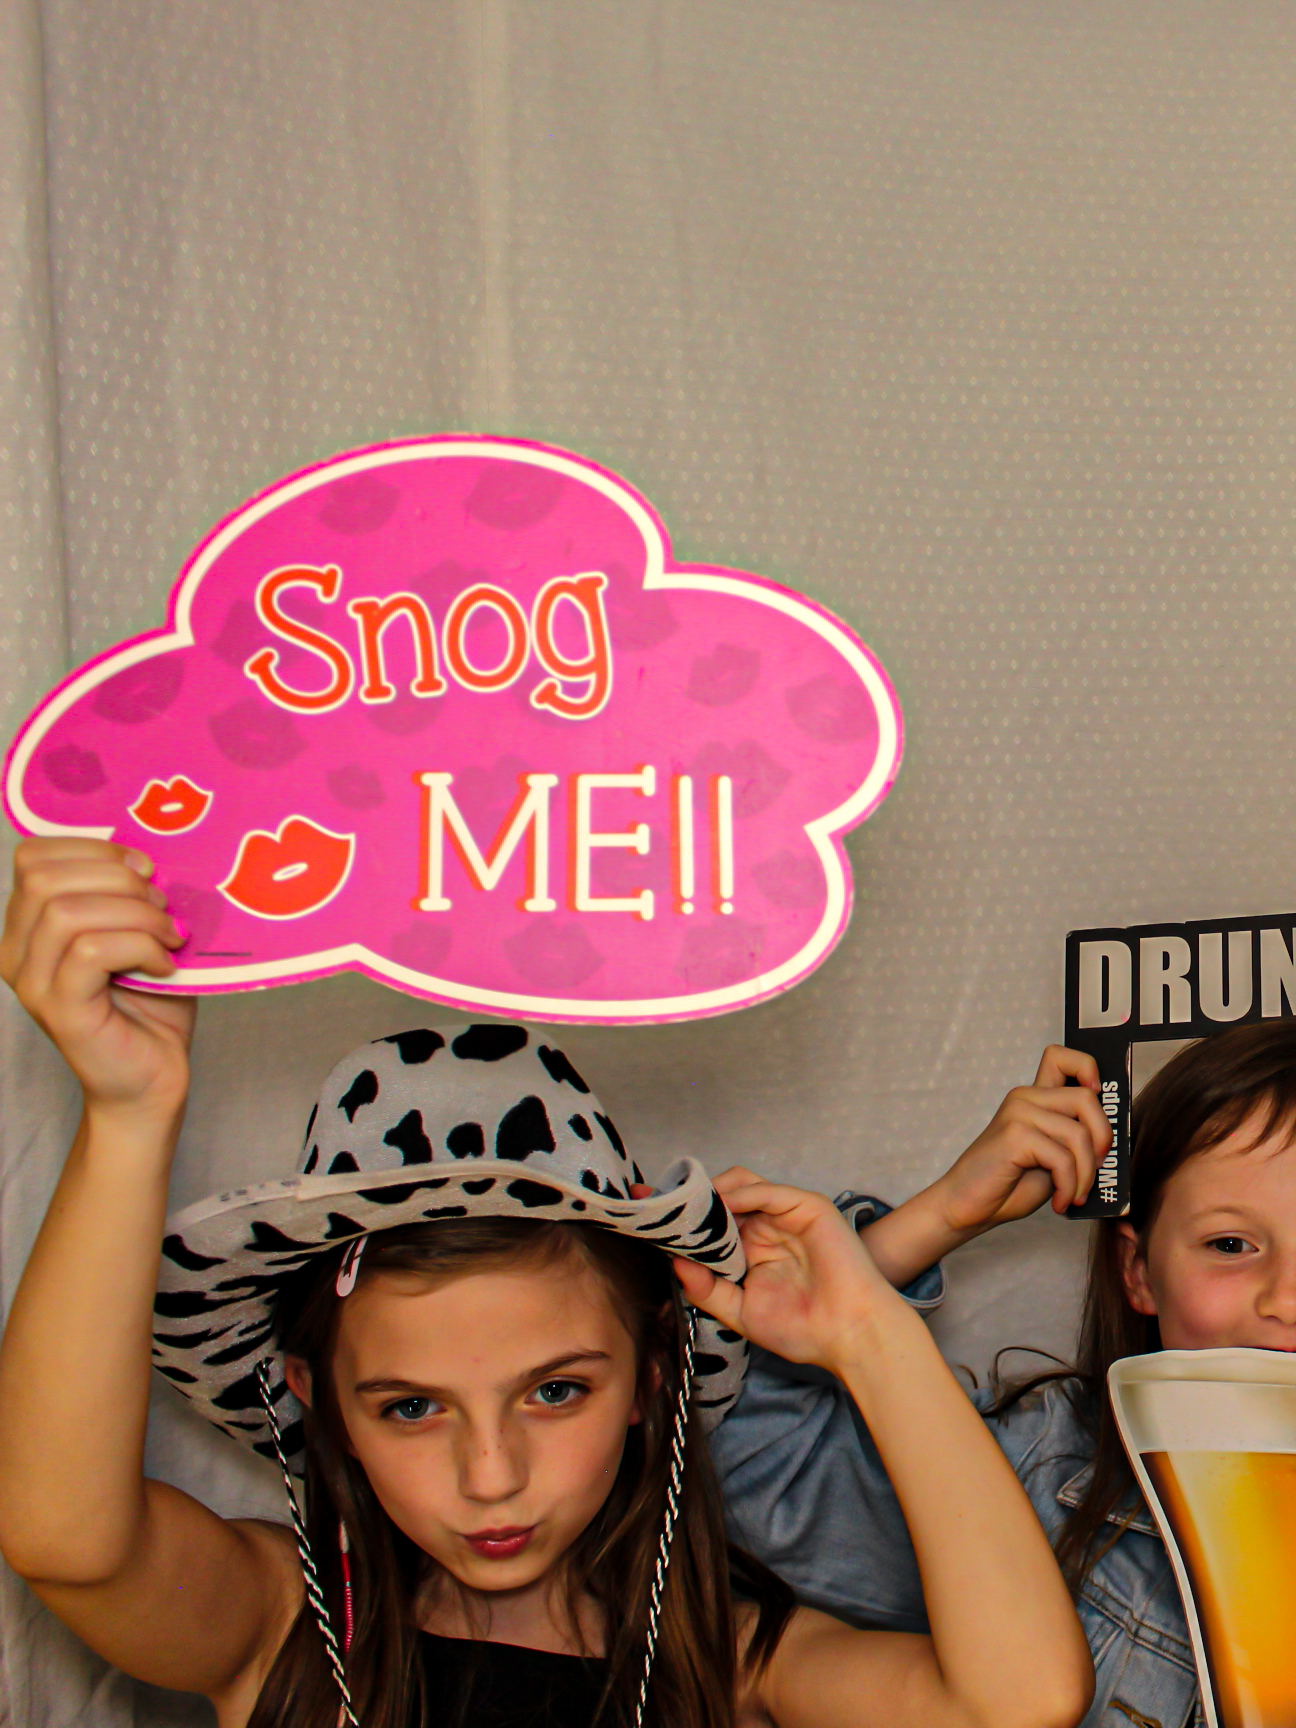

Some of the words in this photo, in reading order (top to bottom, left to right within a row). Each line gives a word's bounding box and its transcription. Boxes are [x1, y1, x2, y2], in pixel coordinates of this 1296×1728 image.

[245, 565, 615, 720] Snog
[411, 764, 735, 921] ME!!
[1098, 1080, 1120, 1203] #Worrops
